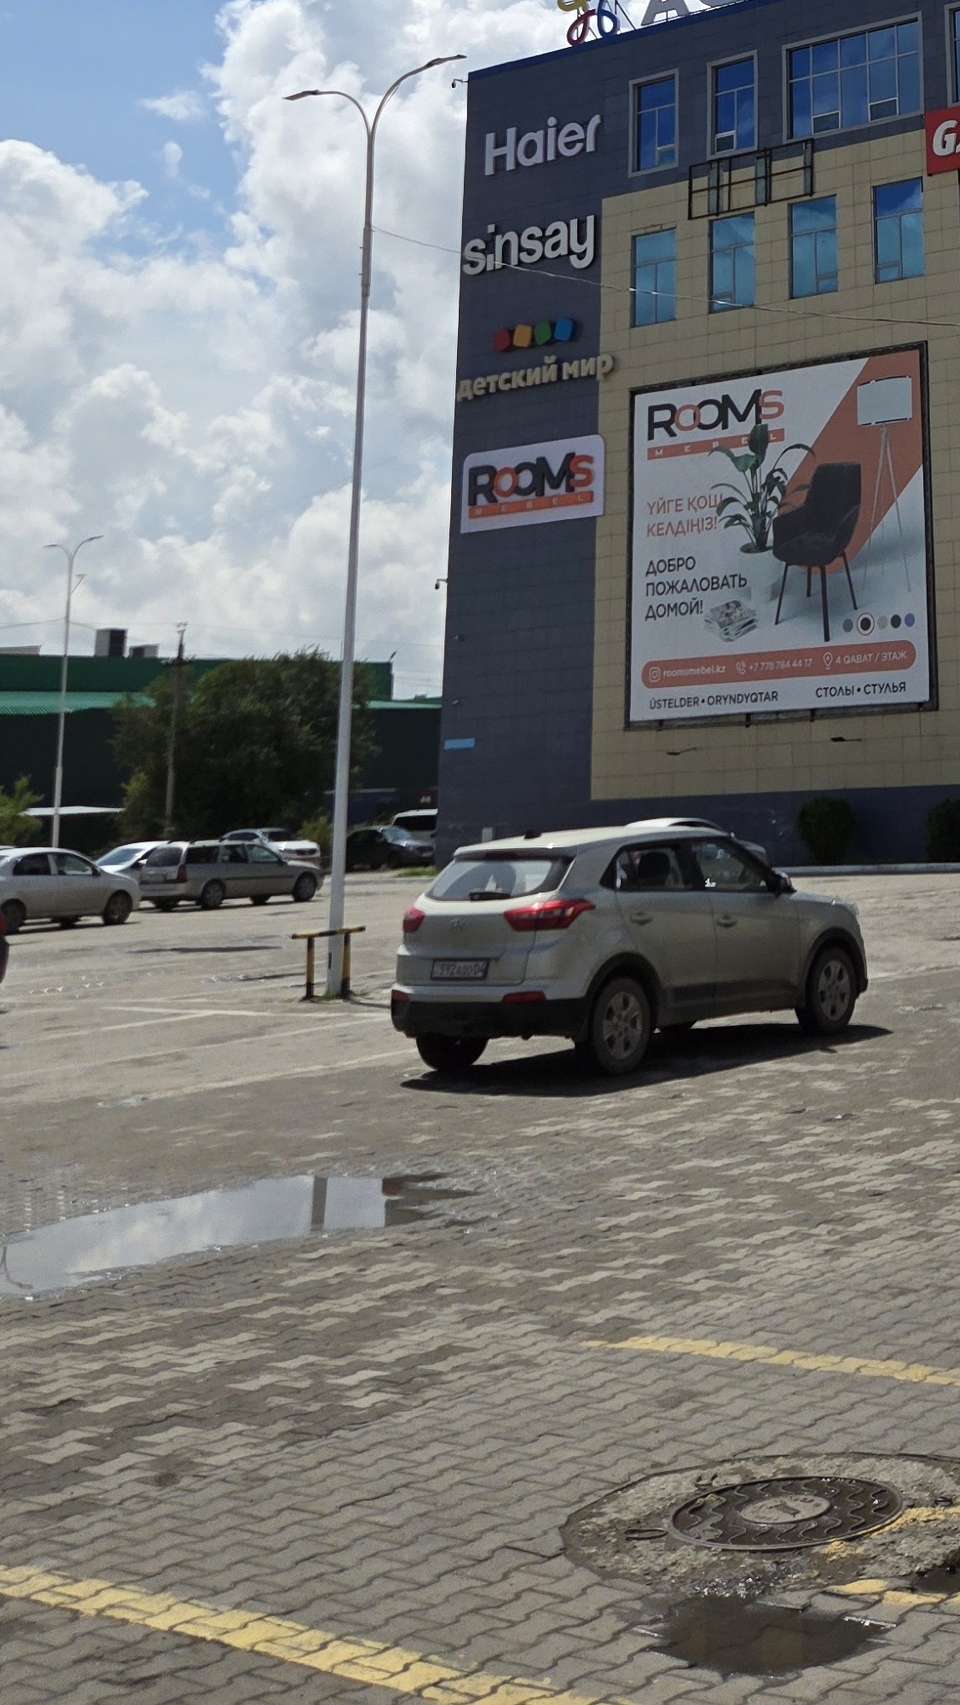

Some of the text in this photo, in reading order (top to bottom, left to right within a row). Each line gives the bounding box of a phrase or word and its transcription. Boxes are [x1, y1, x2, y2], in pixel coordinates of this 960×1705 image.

[484, 113, 602, 176] Haier
[462, 214, 596, 276] sinsay
[457, 353, 614, 402] детский мир
[647, 388, 785, 441] ROOMS
[468, 452, 594, 506] ROOMS
[646, 556, 696, 577] ДОБРО
[646, 573, 748, 597] ПОЖАЛОВАТЬ
[645, 597, 704, 621] ДОМОЙ!
[835, 655, 841, 664] 4
[843, 652, 874, 665] QABAT
[881, 649, 908, 662] ЭТАЖ
[663, 663, 727, 678] roomsmebel.kz
[707, 691, 779, 707] ORYNDYQTAR
[815, 681, 907, 698] СТОЛЫ СТУЛЬЯ
